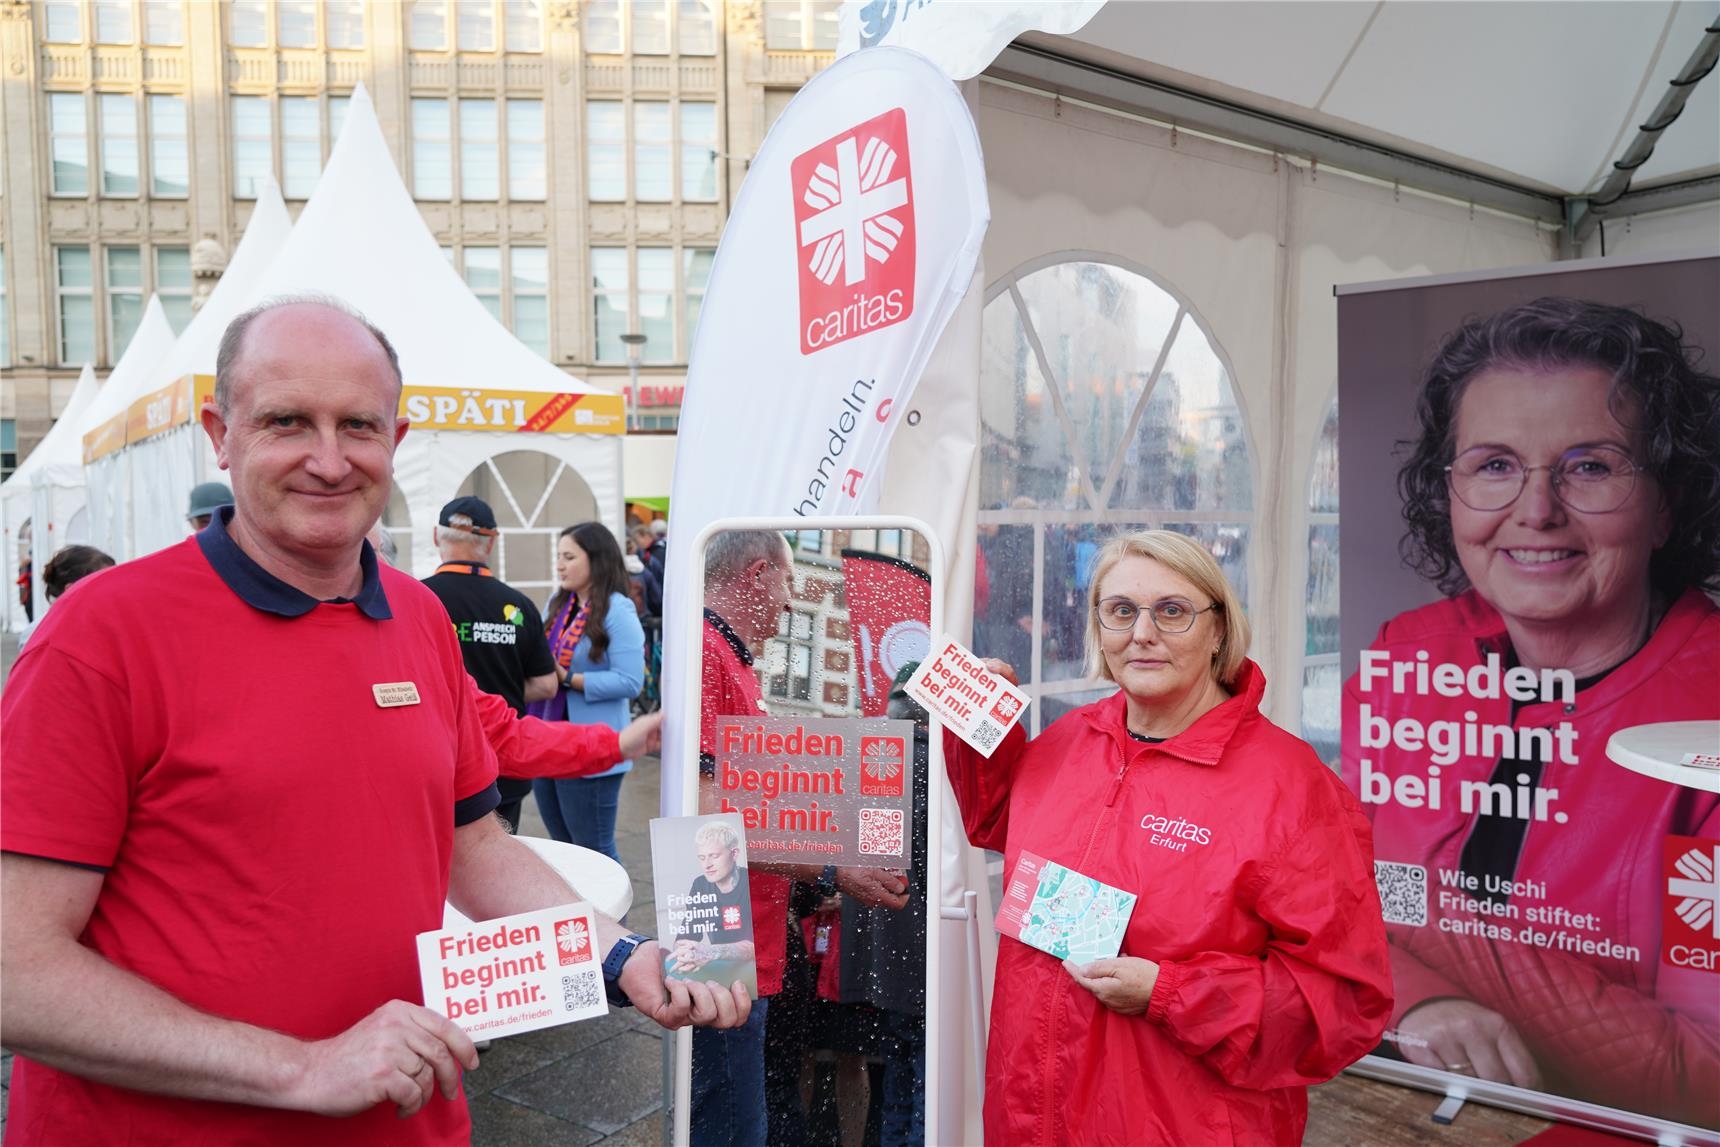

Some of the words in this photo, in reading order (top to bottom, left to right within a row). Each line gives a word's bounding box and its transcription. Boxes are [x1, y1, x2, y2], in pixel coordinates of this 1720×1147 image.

[807, 289, 904, 348] caritas
[406, 390, 527, 426] SPÄTI
[793, 379, 875, 517] handeln.
[473, 622, 516, 634] ANSPRECH
[473, 632, 517, 645] PERSON
[931, 658, 988, 708] beginnt
[943, 643, 997, 692] Frieden
[1359, 650, 1575, 704] Frieden
[920, 672, 947, 698] bei
[944, 693, 972, 721] mir.
[723, 725, 844, 756] Frieden
[1359, 703, 1579, 765] beginnt
[722, 760, 845, 799] beginnt
[862, 783, 900, 796] caritas
[1360, 759, 1441, 810] bei
[1460, 773, 1569, 824] mir.
[779, 801, 839, 833] mir.
[1140, 814, 1212, 845] caritas
[1150, 834, 1187, 853] Erfurt
[667, 891, 717, 906] Frieden
[1438, 868, 1479, 890] Wie
[1484, 874, 1546, 899] Uschi
[668, 905, 719, 922] beginnt
[669, 921, 689, 935] bei
[693, 920, 718, 933] mir.
[1439, 891, 1519, 919] Frieden
[1525, 906, 1601, 932] stiftet:
[439, 924, 541, 960] Frieden
[1438, 917, 1640, 962] caritas.de/frieden
[1670, 945, 1720, 970] car
[442, 950, 546, 990] beginnt
[560, 952, 590, 966] caritas
[446, 989, 488, 1019] bei
[496, 981, 546, 1009] mir.
